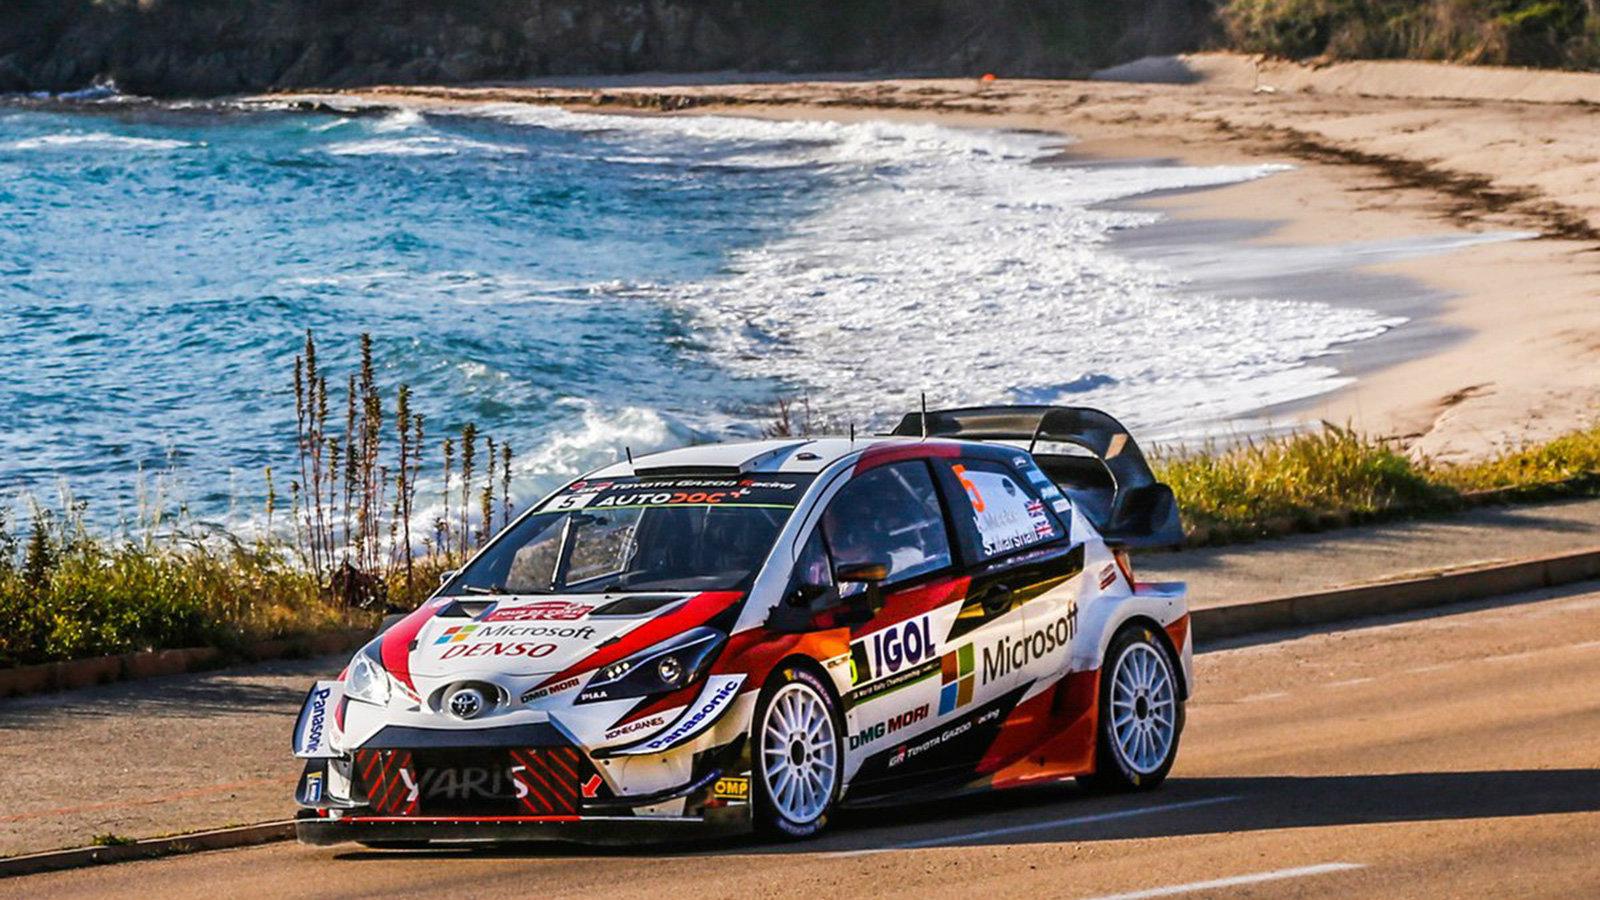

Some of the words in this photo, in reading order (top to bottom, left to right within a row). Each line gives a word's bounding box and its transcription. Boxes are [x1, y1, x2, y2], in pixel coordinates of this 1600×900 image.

[612, 481, 674, 490] TOYOTA
[739, 479, 796, 489] Racing
[952, 464, 985, 512] 5
[478, 624, 597, 640] Microsoft
[873, 615, 936, 678] IGOL
[983, 601, 1078, 686] Microsoft
[440, 642, 558, 660] DENSO
[521, 689, 549, 703] DMG
[550, 678, 580, 695] MORI
[582, 691, 608, 700] PIAA
[305, 686, 331, 754] Panasonic
[605, 717, 664, 740] KONECRANES
[647, 681, 738, 749] Panasonic
[850, 722, 887, 751] DMG
[888, 703, 929, 734] MORI
[400, 765, 529, 801] YARIS
[714, 781, 748, 794] OMP
